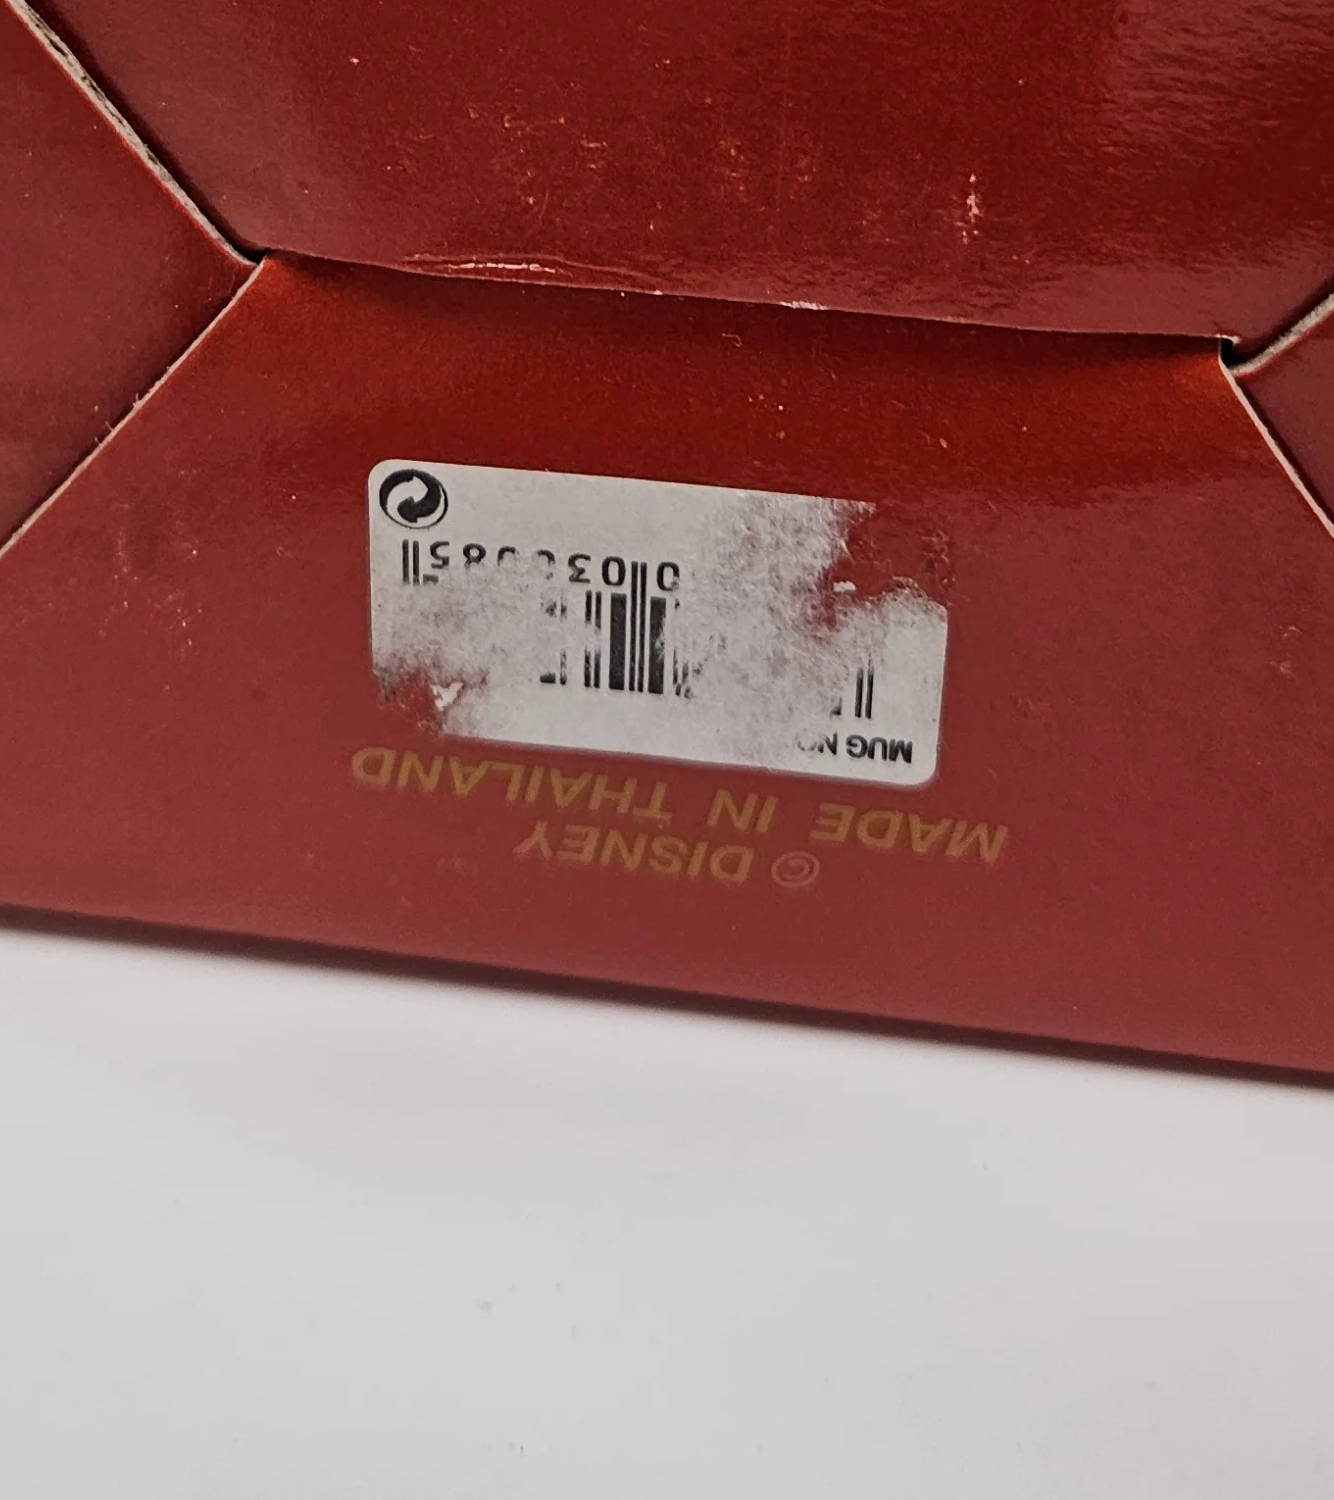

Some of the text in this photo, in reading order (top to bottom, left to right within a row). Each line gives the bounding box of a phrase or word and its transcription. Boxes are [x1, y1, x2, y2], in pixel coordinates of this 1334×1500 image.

[845, 734, 913, 765] MUG
[351, 745, 1009, 864] MADE IN THAILAND
[514, 820, 755, 884] DISNEY
